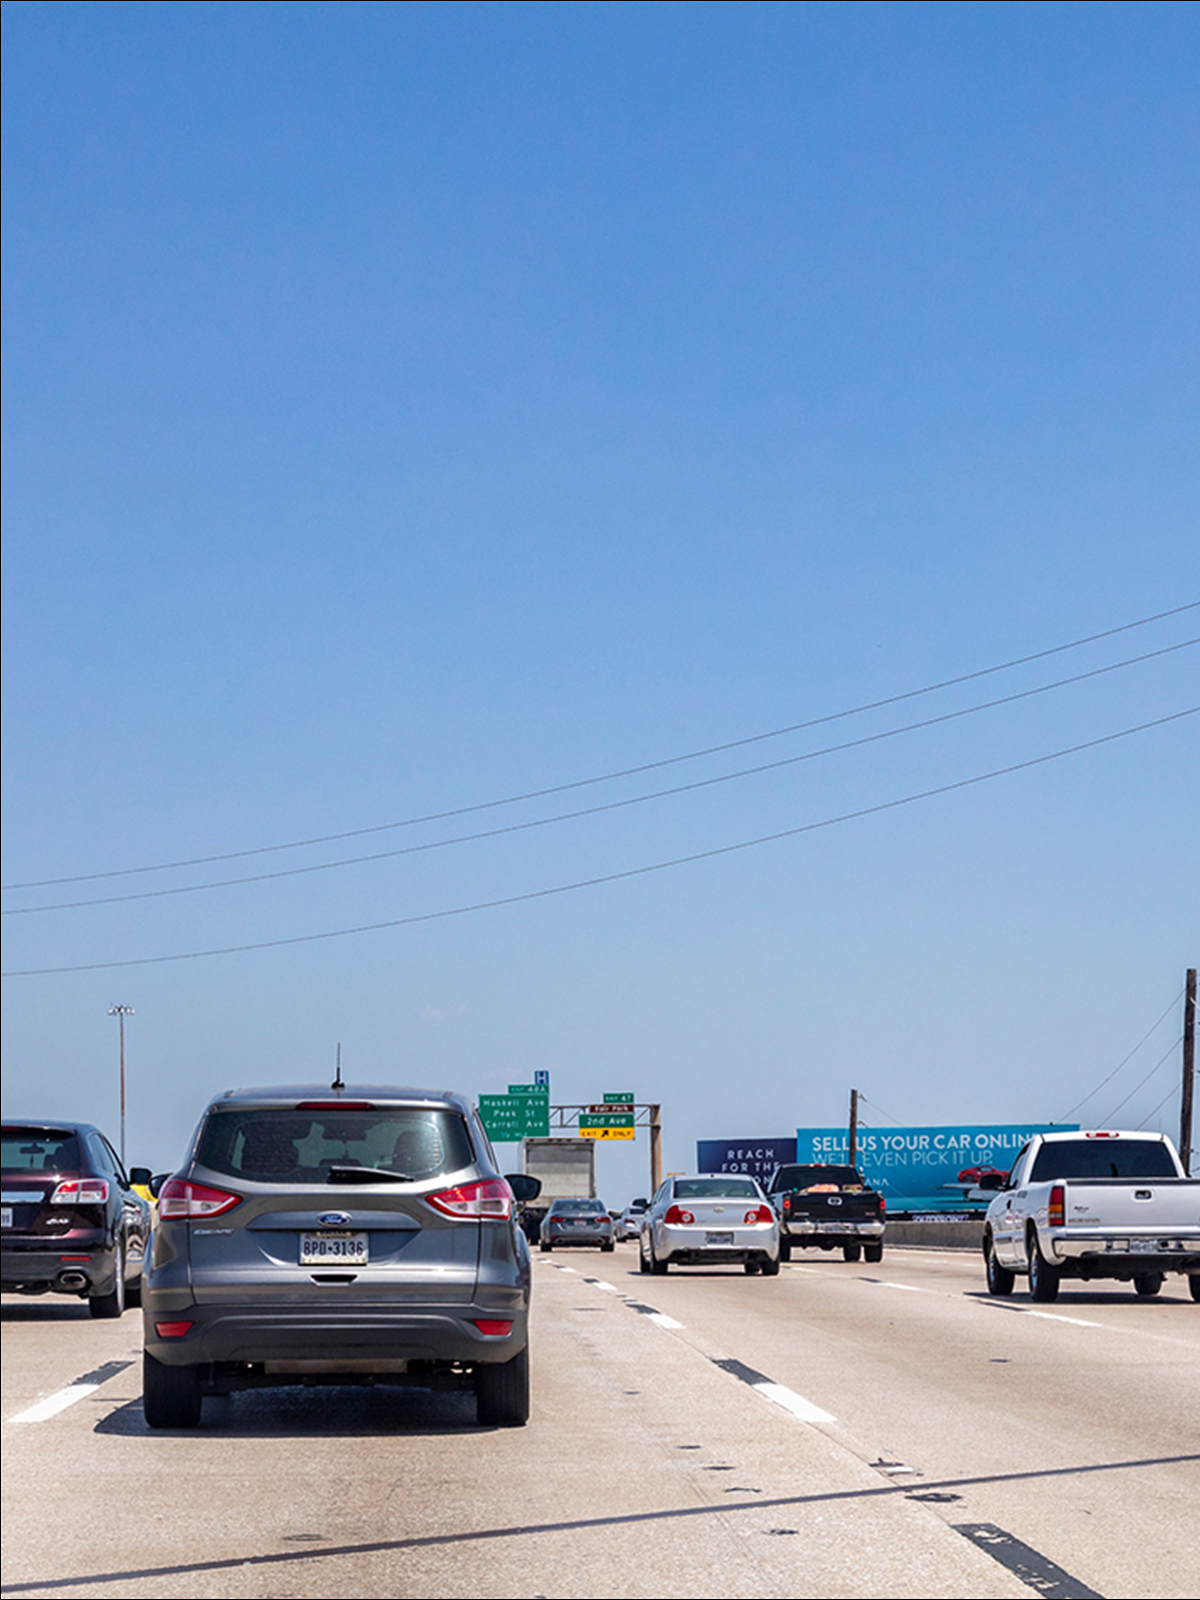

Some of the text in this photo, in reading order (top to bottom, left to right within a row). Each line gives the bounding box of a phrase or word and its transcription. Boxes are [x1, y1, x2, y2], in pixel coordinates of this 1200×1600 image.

[621, 1094, 631, 1102] 47
[483, 1099, 545, 1107] Haskell Ave
[493, 1110, 535, 1118] Peak St
[485, 1120, 544, 1129] Carroll Ave
[587, 1117, 627, 1126] 2nd Ave
[811, 1133, 1037, 1152] SELL US YOUR CAR ONLIN
[727, 1148, 774, 1160] REACH
[862, 1150, 907, 1167] EVEN
[912, 1150, 949, 1166] PICK
[952, 1150, 965, 1165] IT
[971, 1149, 993, 1164] UP.
[721, 1161, 780, 1173] FOR THE
